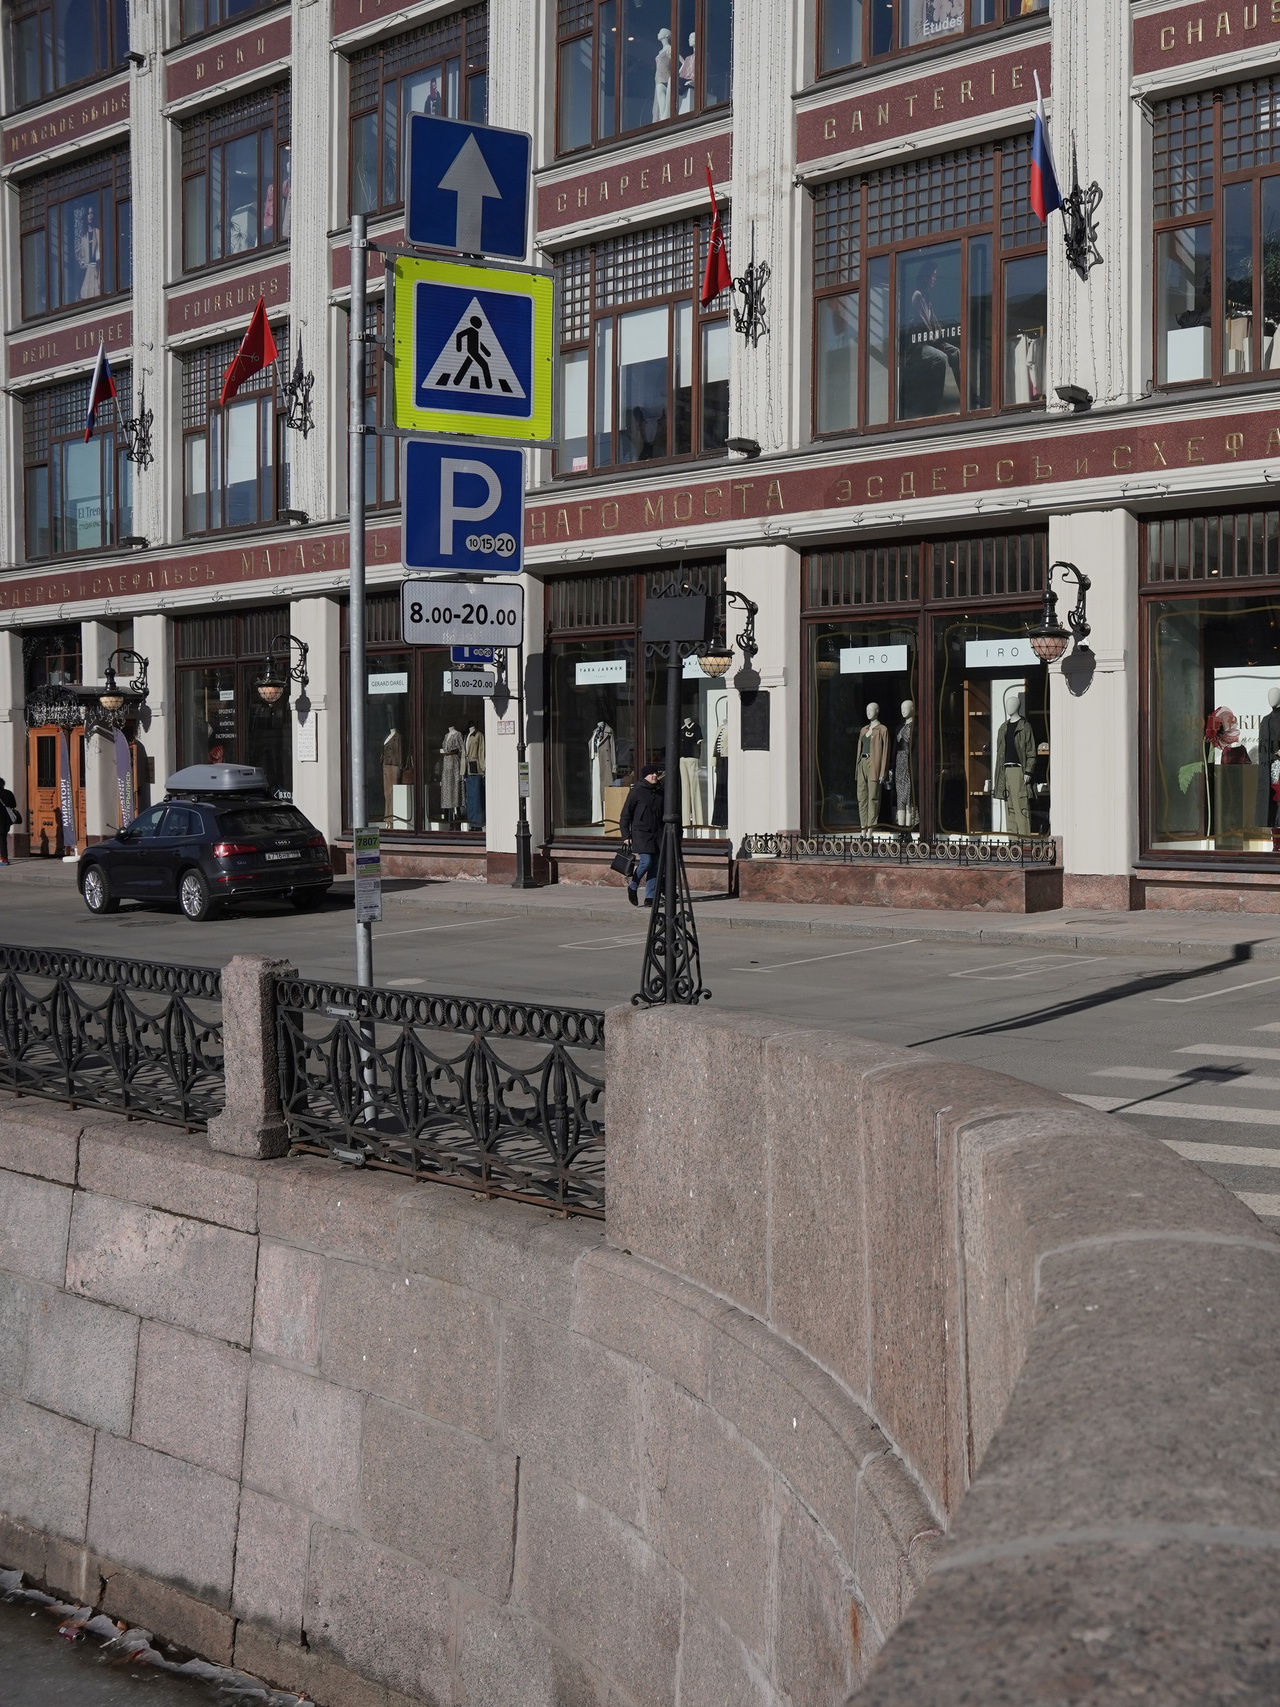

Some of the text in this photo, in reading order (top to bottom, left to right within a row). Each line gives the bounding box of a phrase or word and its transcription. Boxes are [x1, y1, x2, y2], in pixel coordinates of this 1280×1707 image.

[923, 17, 963, 36] Études
[196, 38, 264, 80] ЮБКИ
[11, 114, 75, 152] МУЖСКОЕ
[557, 151, 714, 213] CHAPEAUX
[184, 278, 278, 320] FOURRURES
[836, 455, 1052, 502] ЭСДЕРСЪ
[440, 457, 502, 555] P
[531, 479, 784, 540] НАГО МОСТА
[241, 534, 388, 576] МАГАЗИЪ
[469, 538, 514, 552] 10 15 20
[93, 565, 215, 595] СХЕФАЛЬСЪ
[410, 602, 517, 626] 8.00-20.00
[858, 654, 888, 664] IRO
[985, 647, 1019, 658] IRO
[454, 679, 493, 689] 8.00-20.00
[60, 778, 69, 827] МИРАТОРГ
[278, 790, 293, 800] ВХО
[357, 837, 378, 847] 7807
